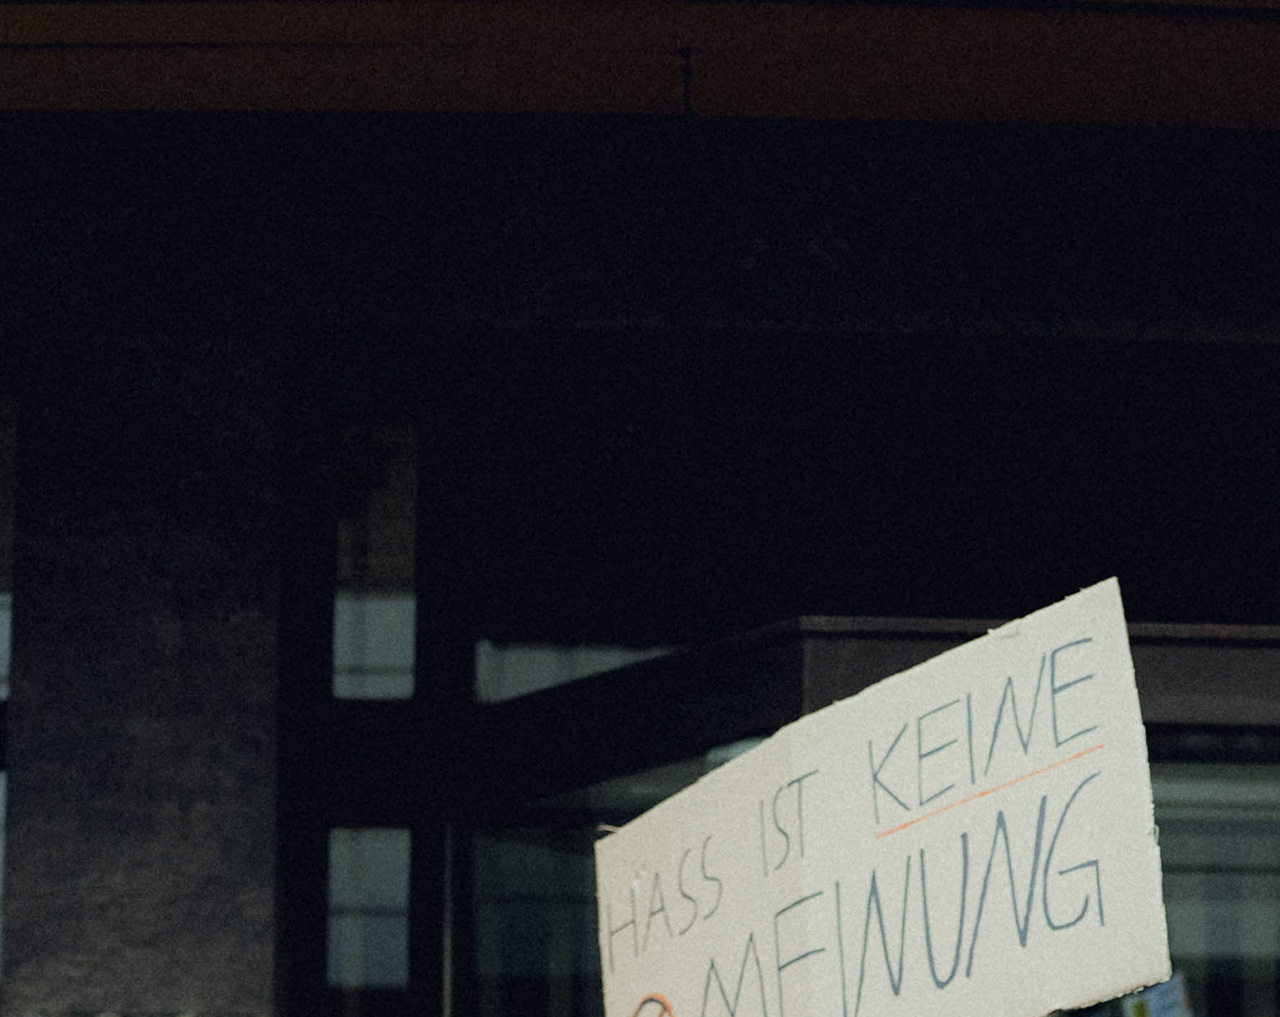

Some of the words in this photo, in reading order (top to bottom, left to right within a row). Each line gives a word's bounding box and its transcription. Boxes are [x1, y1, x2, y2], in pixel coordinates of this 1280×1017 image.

[607, 834, 723, 974] HASS
[760, 769, 819, 877] IST
[868, 637, 1099, 825] KEINE
